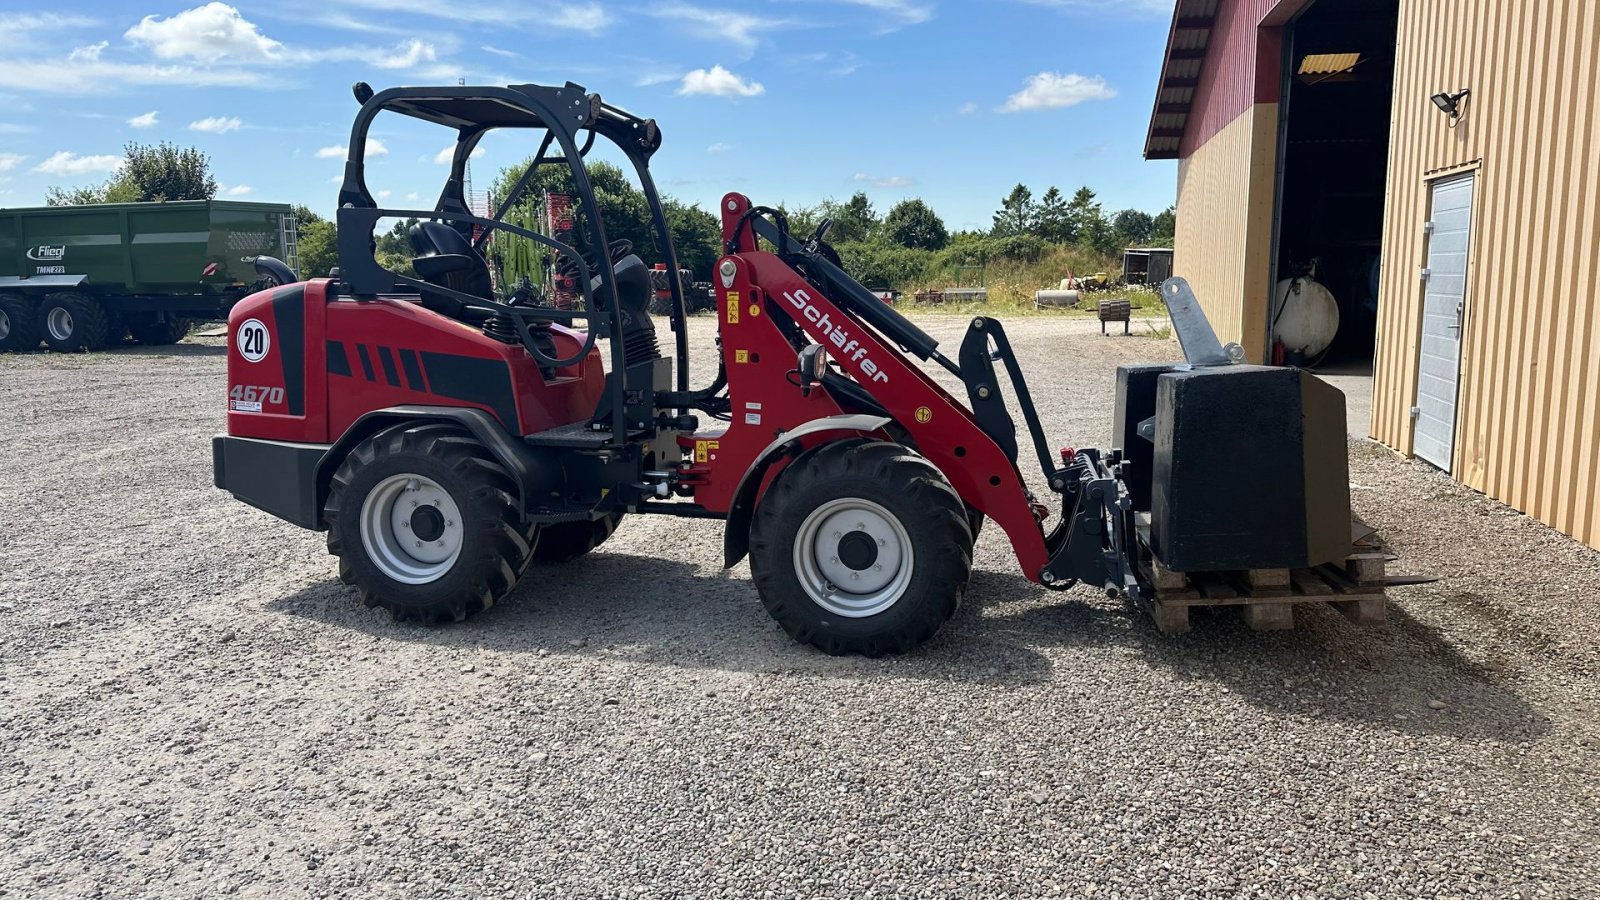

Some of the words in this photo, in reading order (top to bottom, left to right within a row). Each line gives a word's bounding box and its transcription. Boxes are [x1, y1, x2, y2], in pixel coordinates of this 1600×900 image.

[38, 245, 65, 260] Fliegl
[244, 327, 264, 355] 20
[783, 289, 889, 384] Schäffer
[230, 384, 284, 404] 4670
